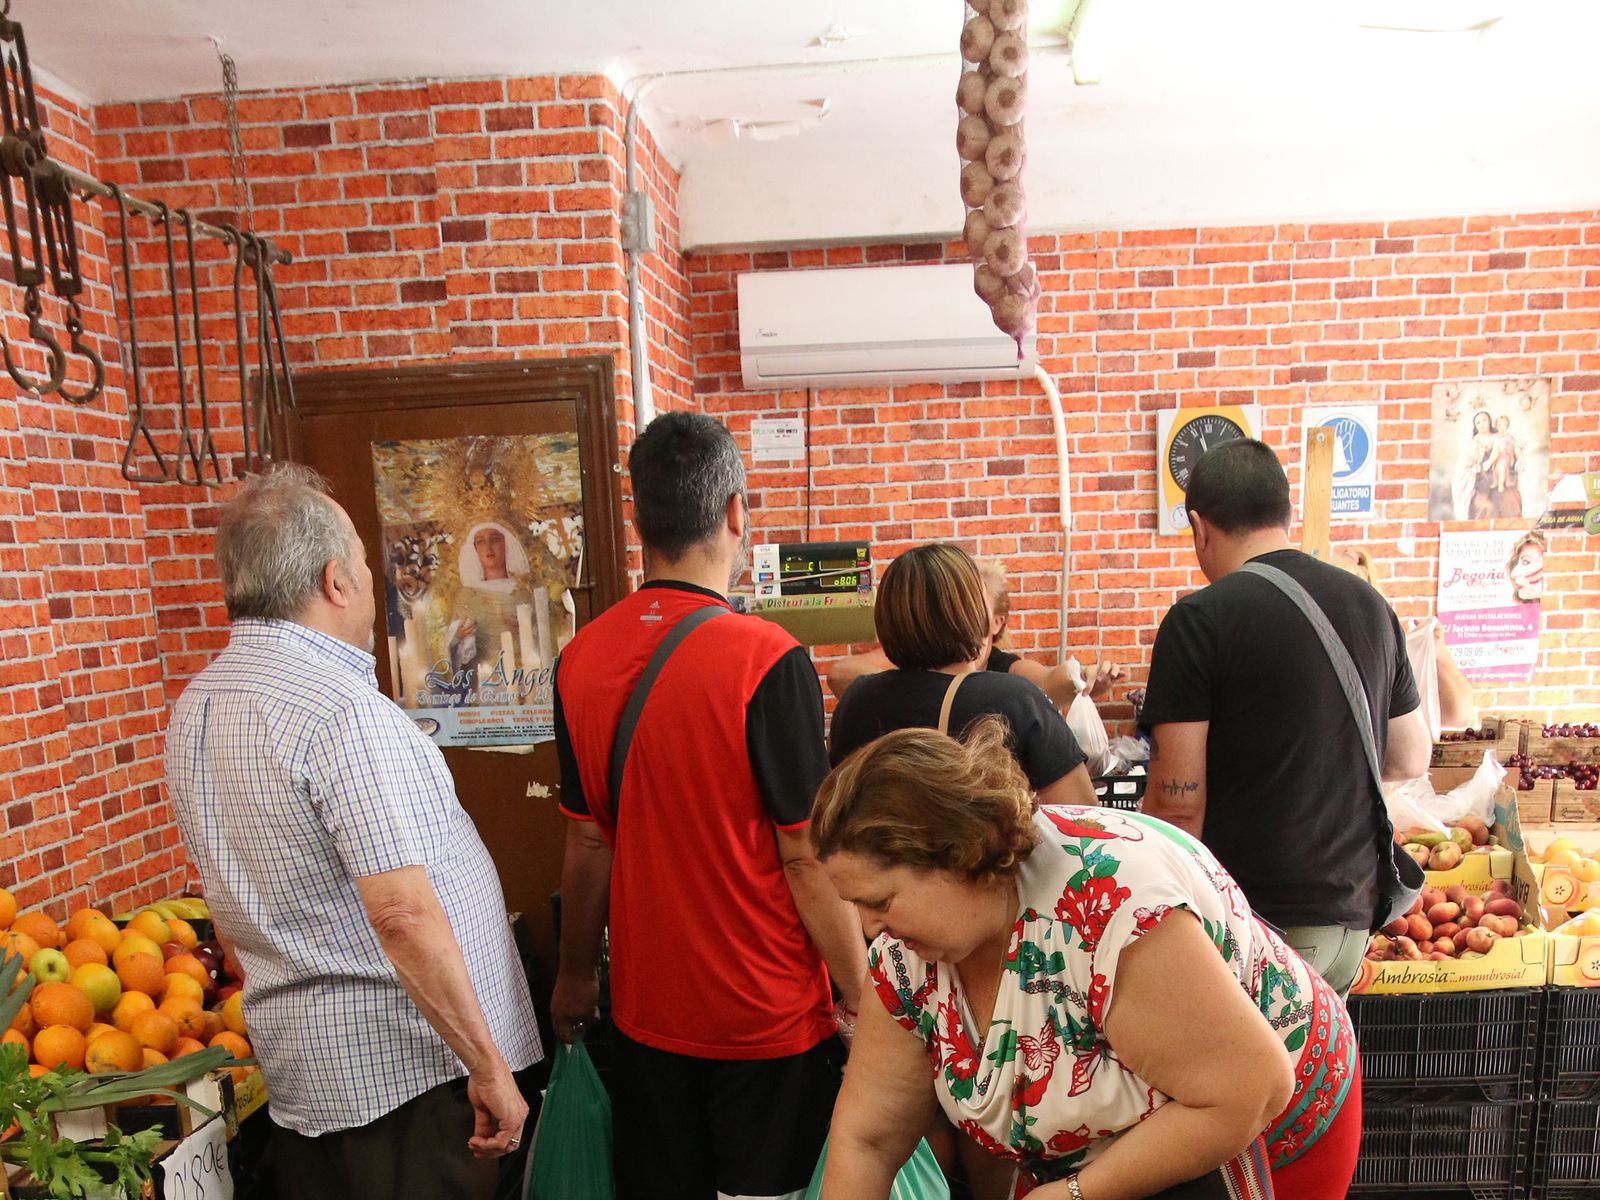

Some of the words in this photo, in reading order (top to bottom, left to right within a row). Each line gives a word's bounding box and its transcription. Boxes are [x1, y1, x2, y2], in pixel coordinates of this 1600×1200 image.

[1332, 487, 1370, 499] LIGATORIO
[1443, 567, 1505, 588] Begoña
[424, 659, 475, 690] Los
[480, 650, 559, 697] Ángel
[1372, 965, 1449, 986] Ambrosia
